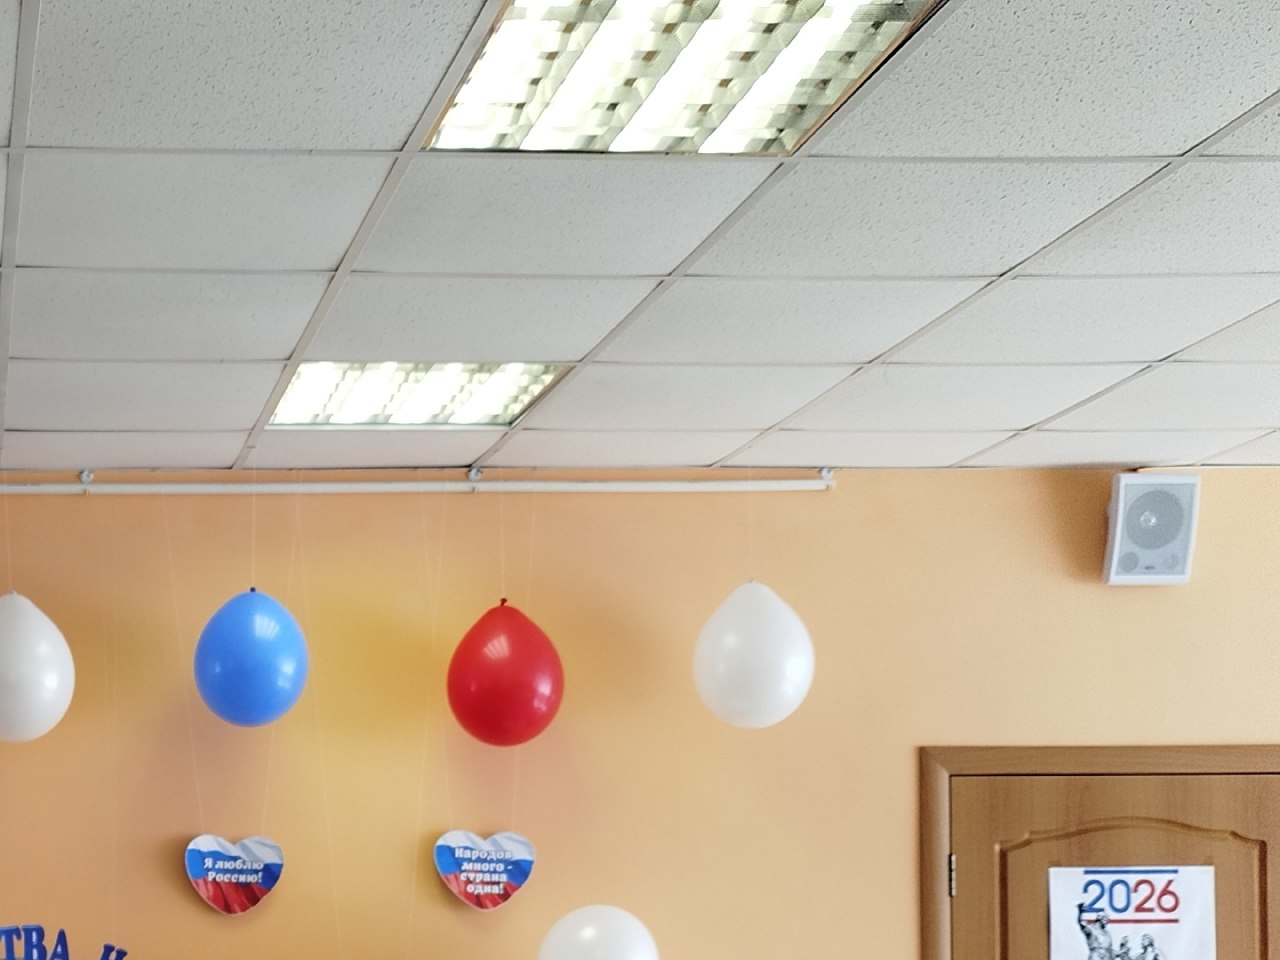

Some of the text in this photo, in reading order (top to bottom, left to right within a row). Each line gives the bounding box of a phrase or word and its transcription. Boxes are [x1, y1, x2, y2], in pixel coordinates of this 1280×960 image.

[455, 847, 513, 861] Народов
[203, 858, 265, 870] Я люблю
[461, 862, 505, 872] много
[207, 871, 263, 883] Россию!
[460, 872, 508, 883] страна
[466, 883, 505, 895] одна!
[1082, 879, 1180, 914] 2026
